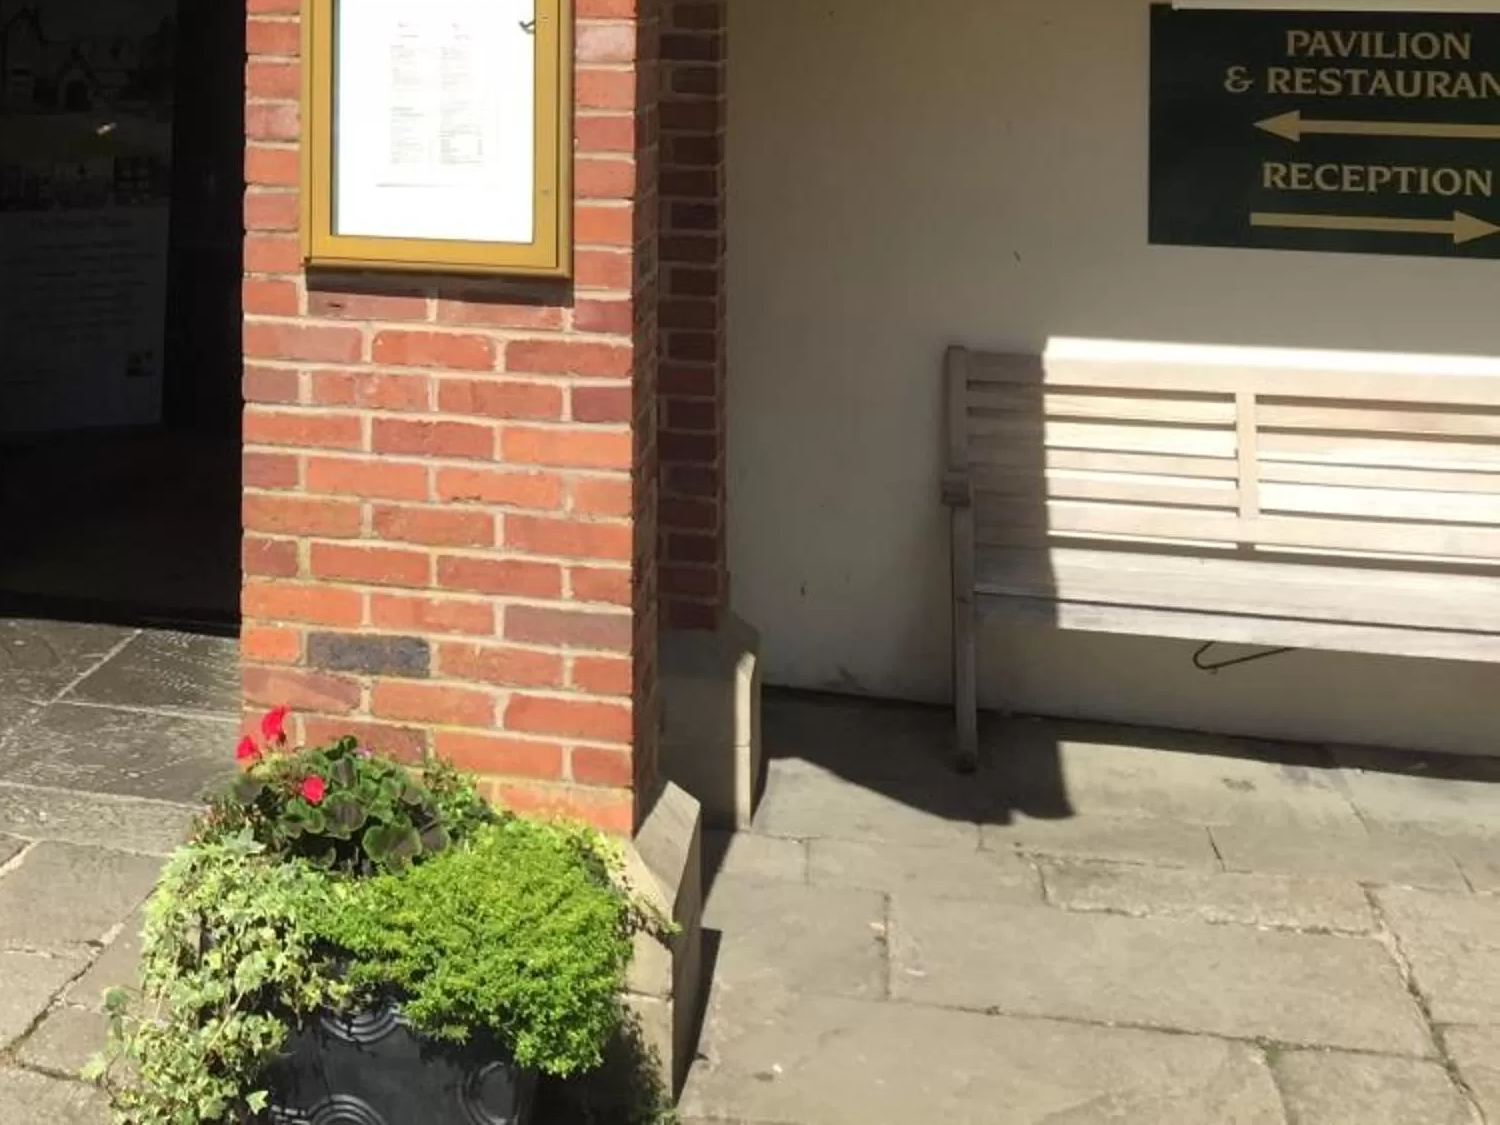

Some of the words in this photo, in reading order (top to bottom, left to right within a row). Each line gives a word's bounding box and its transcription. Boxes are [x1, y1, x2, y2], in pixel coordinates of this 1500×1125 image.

[1286, 29, 1472, 60] PAVILION
[1224, 65, 1254, 93] &
[1267, 67, 1500, 99] RESTAURAN
[1263, 162, 1493, 197] RECEPTION
